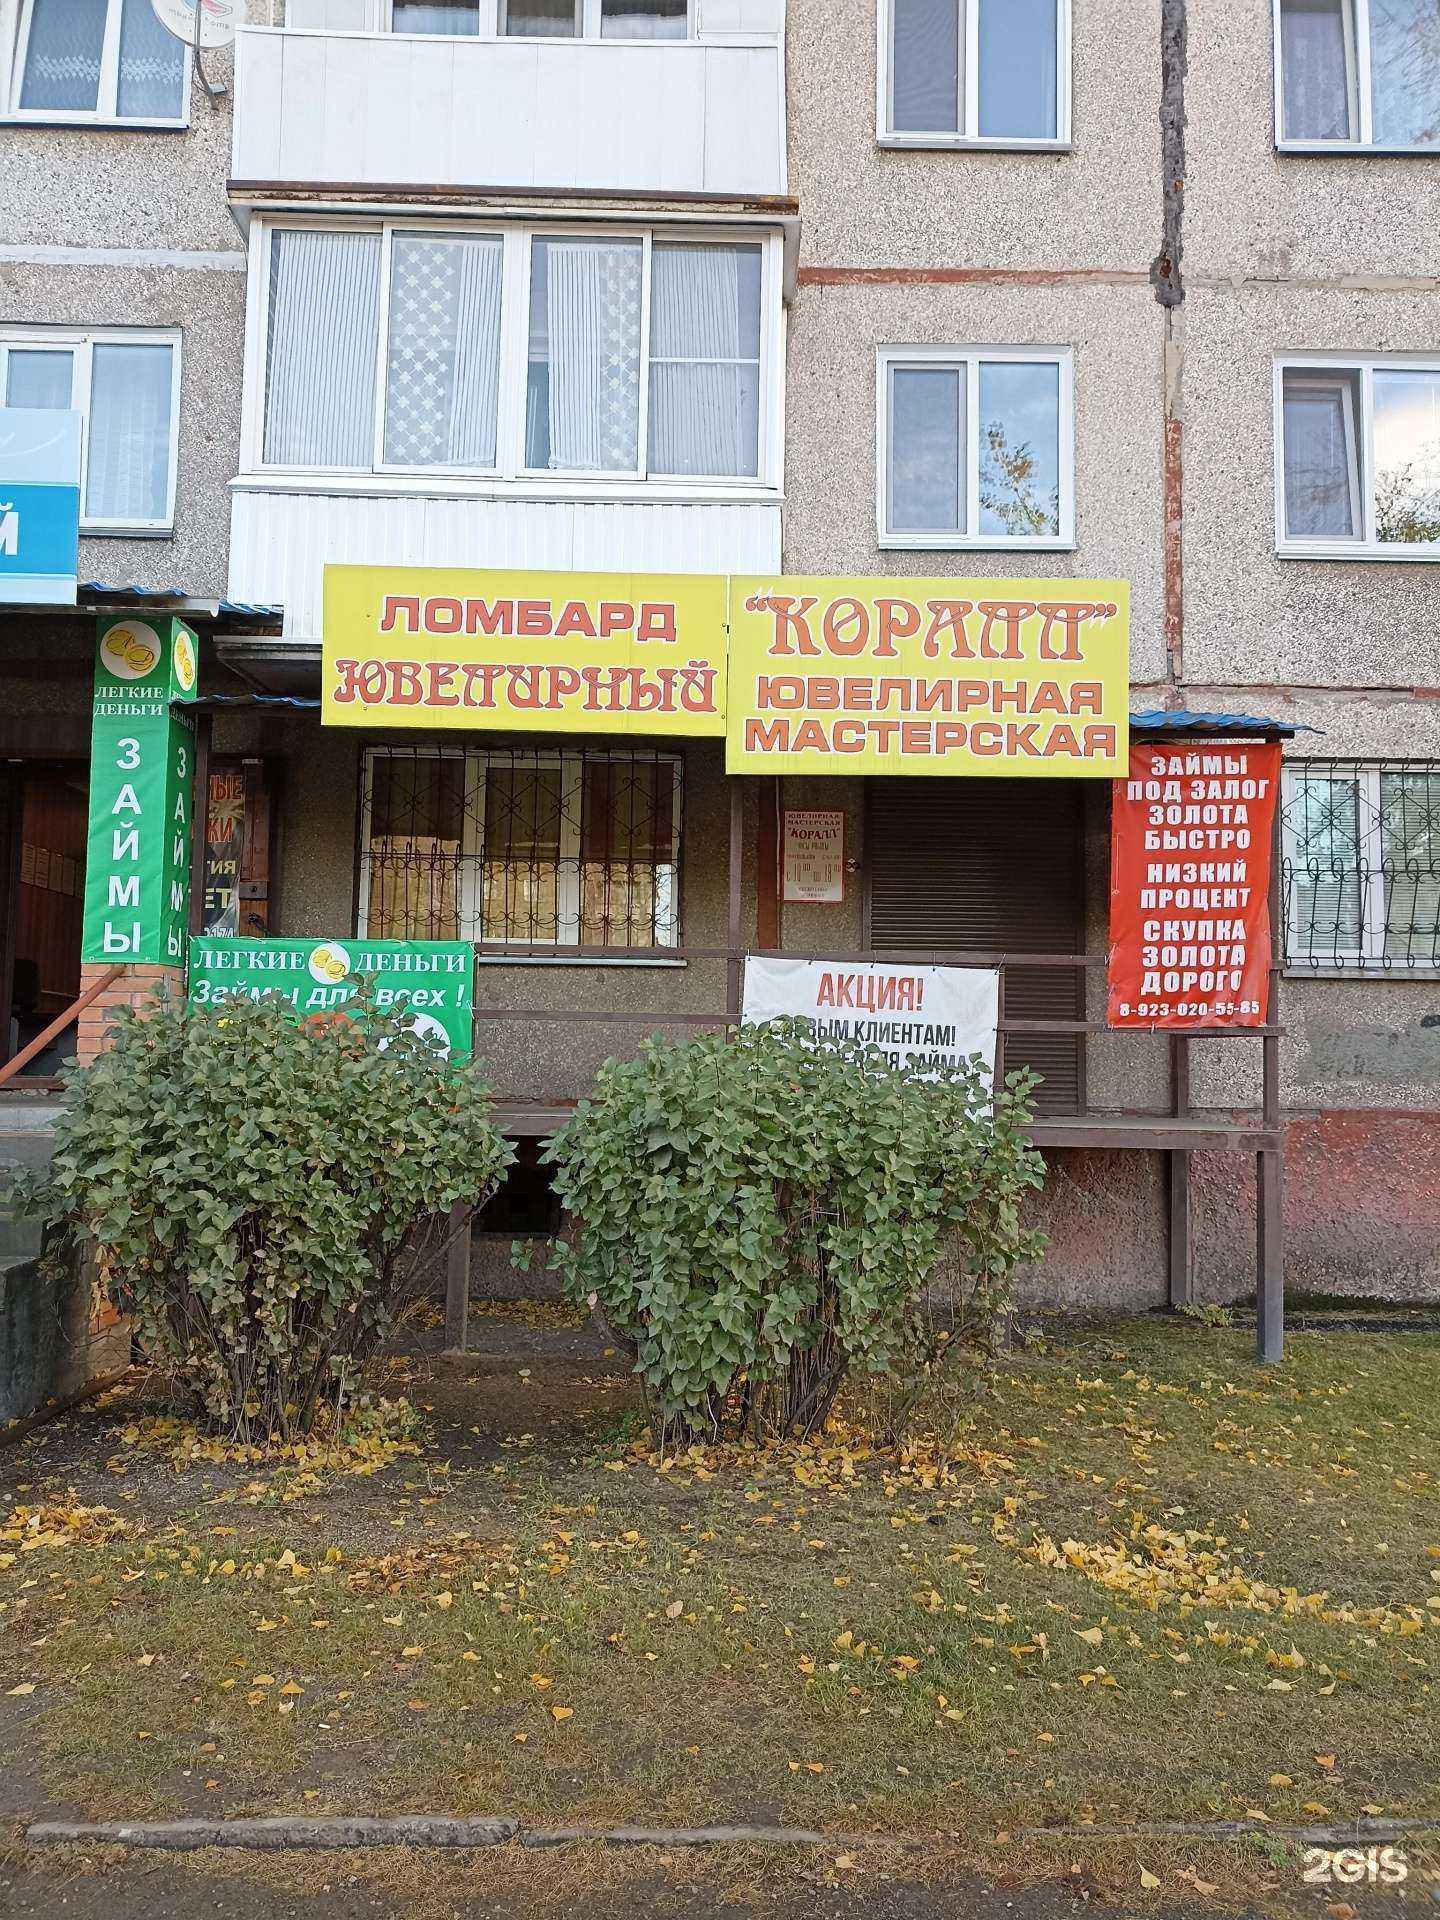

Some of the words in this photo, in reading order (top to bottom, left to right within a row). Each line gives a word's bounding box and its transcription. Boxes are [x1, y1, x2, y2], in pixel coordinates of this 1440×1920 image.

[380, 595, 677, 642] ЛОМБАРД
[94, 685, 164, 699] ЛЕГКИЕ
[333, 659, 718, 713] ЮВЕЛИРНЫЙ
[757, 676, 1103, 715] ЮВЕЛИРНАЯ
[93, 702, 163, 717] ДЕНЬГИ
[745, 719, 1116, 758] МАСТЕРСКАЯ
[1151, 753, 1248, 776] ЗАЙМЫ
[1127, 780, 1182, 803] ПОД
[1190, 779, 1270, 801] ЗАЛОГ
[1149, 804, 1249, 825] ЗОЛОТА
[103, 737, 143, 953] ЗАЙМЫ
[1145, 829, 1251, 850] БЫСТРО
[167, 747, 187, 958] ЗАЙМЫ
[1147, 859, 1246, 883] НИЗКИЙ
[1141, 888, 1251, 911] ПРОЦЕНТ
[1143, 919, 1247, 942] СКУПКА
[193, 950, 306, 970] ЛЕГКИЕ
[355, 953, 467, 973] ДЕНЬГИ
[1142, 945, 1246, 968] ЗОЛОТА
[816, 973, 924, 1013] АКЦИЯ!
[1140, 970, 1243, 996] ДОРОГО
[854, 1021, 957, 1047] КЛИЕНТАМ!
